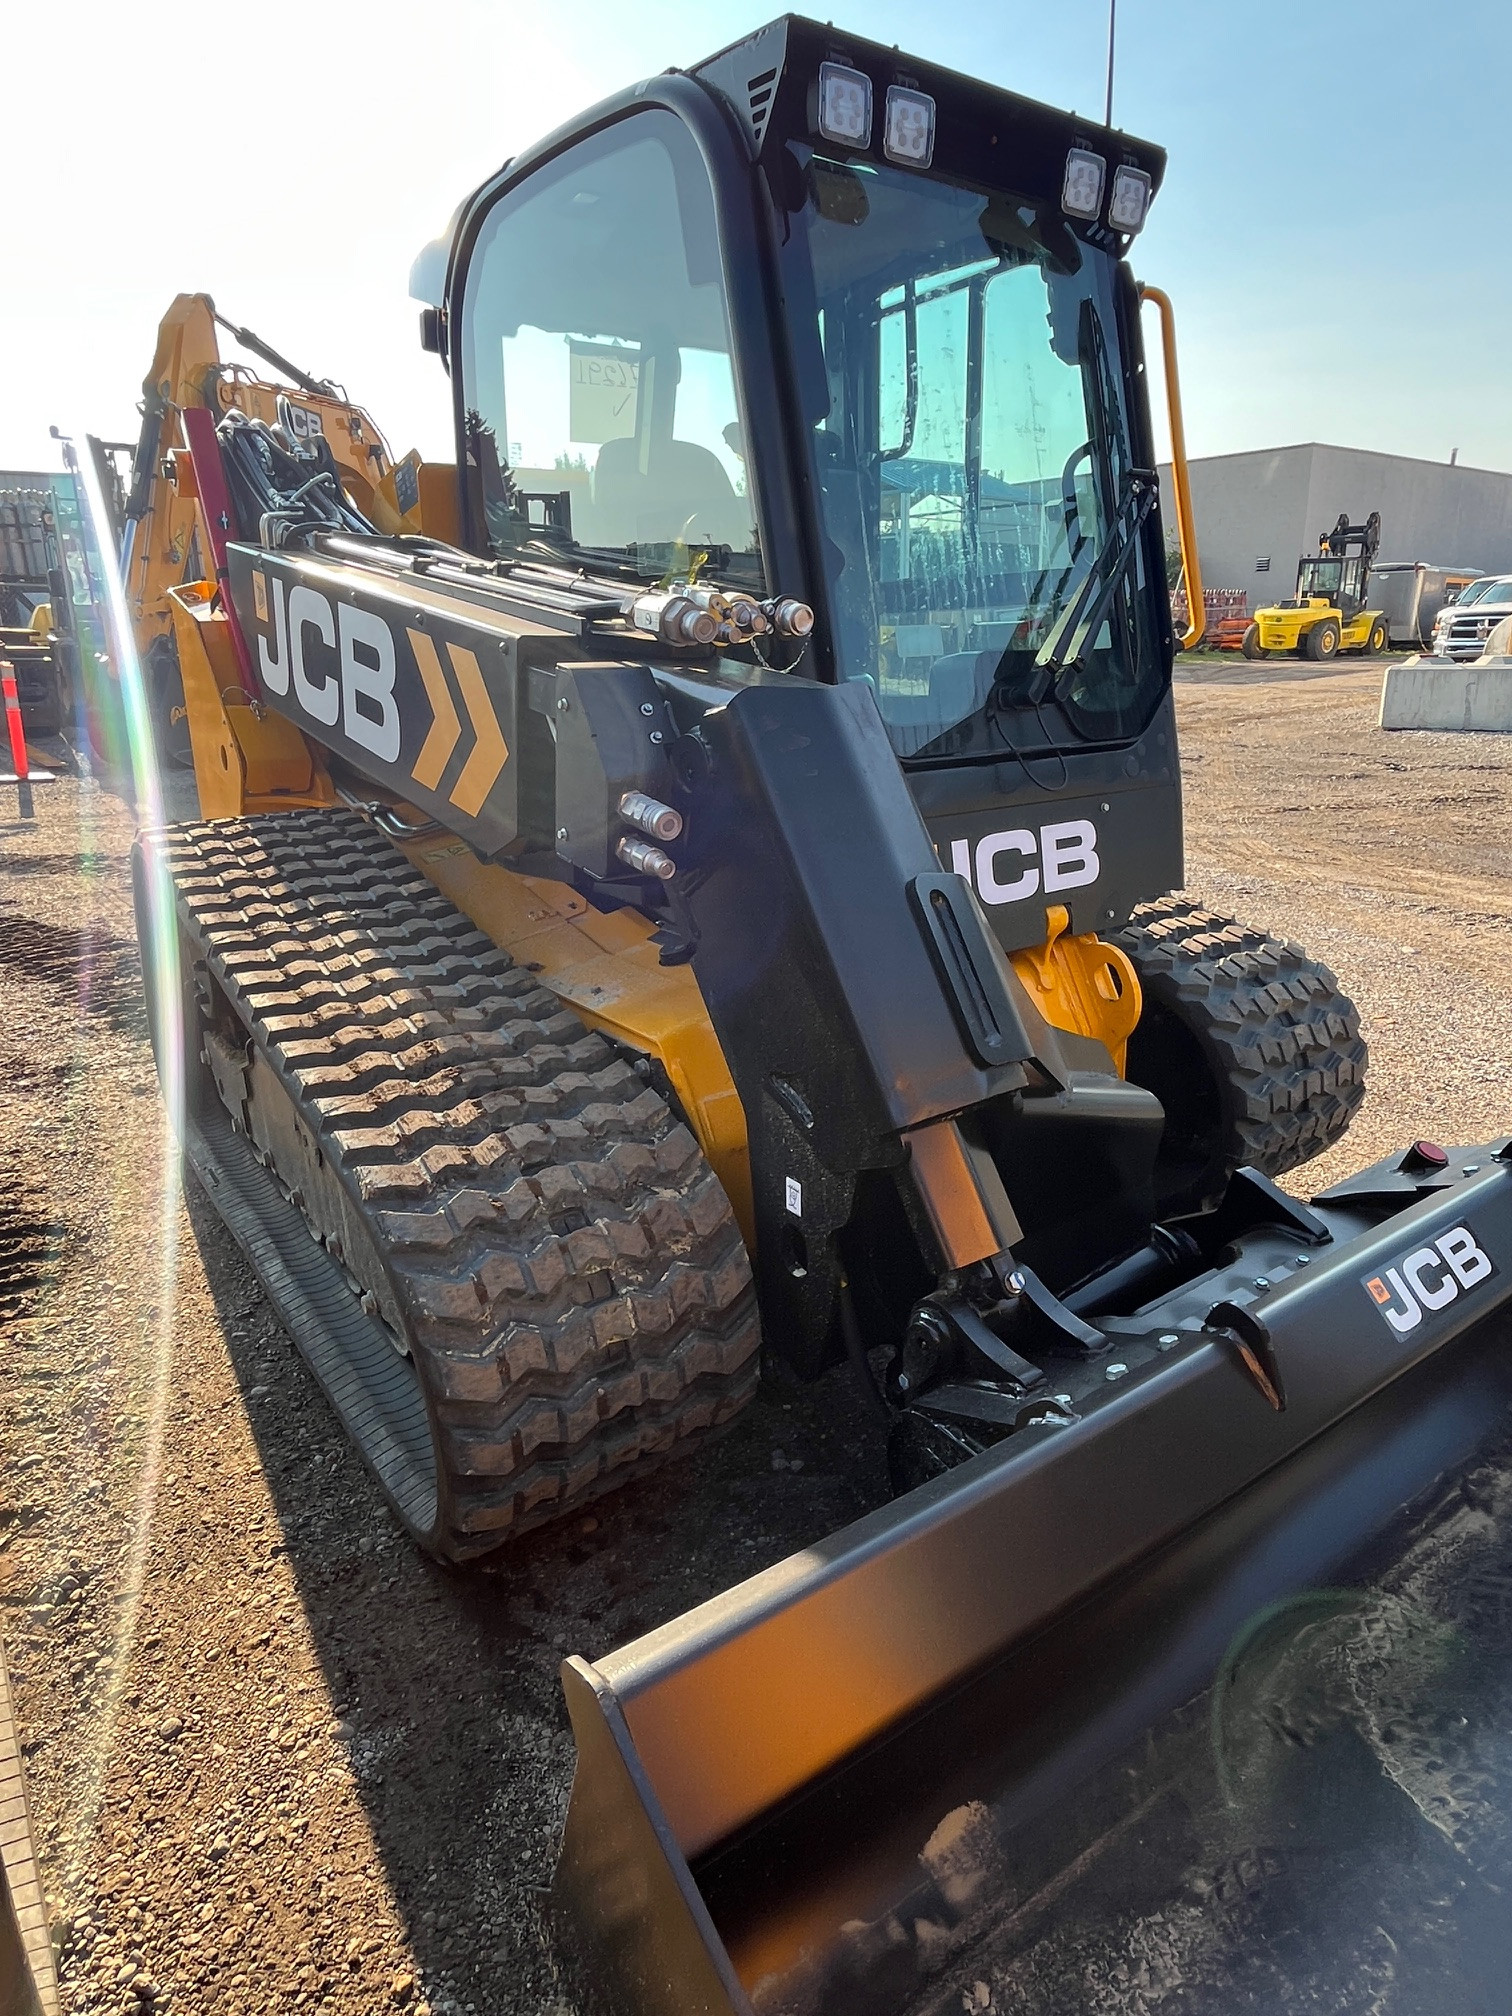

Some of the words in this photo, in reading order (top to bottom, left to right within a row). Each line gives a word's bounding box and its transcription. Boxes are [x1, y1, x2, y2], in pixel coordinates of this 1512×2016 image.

[291, 406, 322, 437] CB
[257, 576, 401, 764] JCB
[1385, 1226, 1492, 1332] JCB
